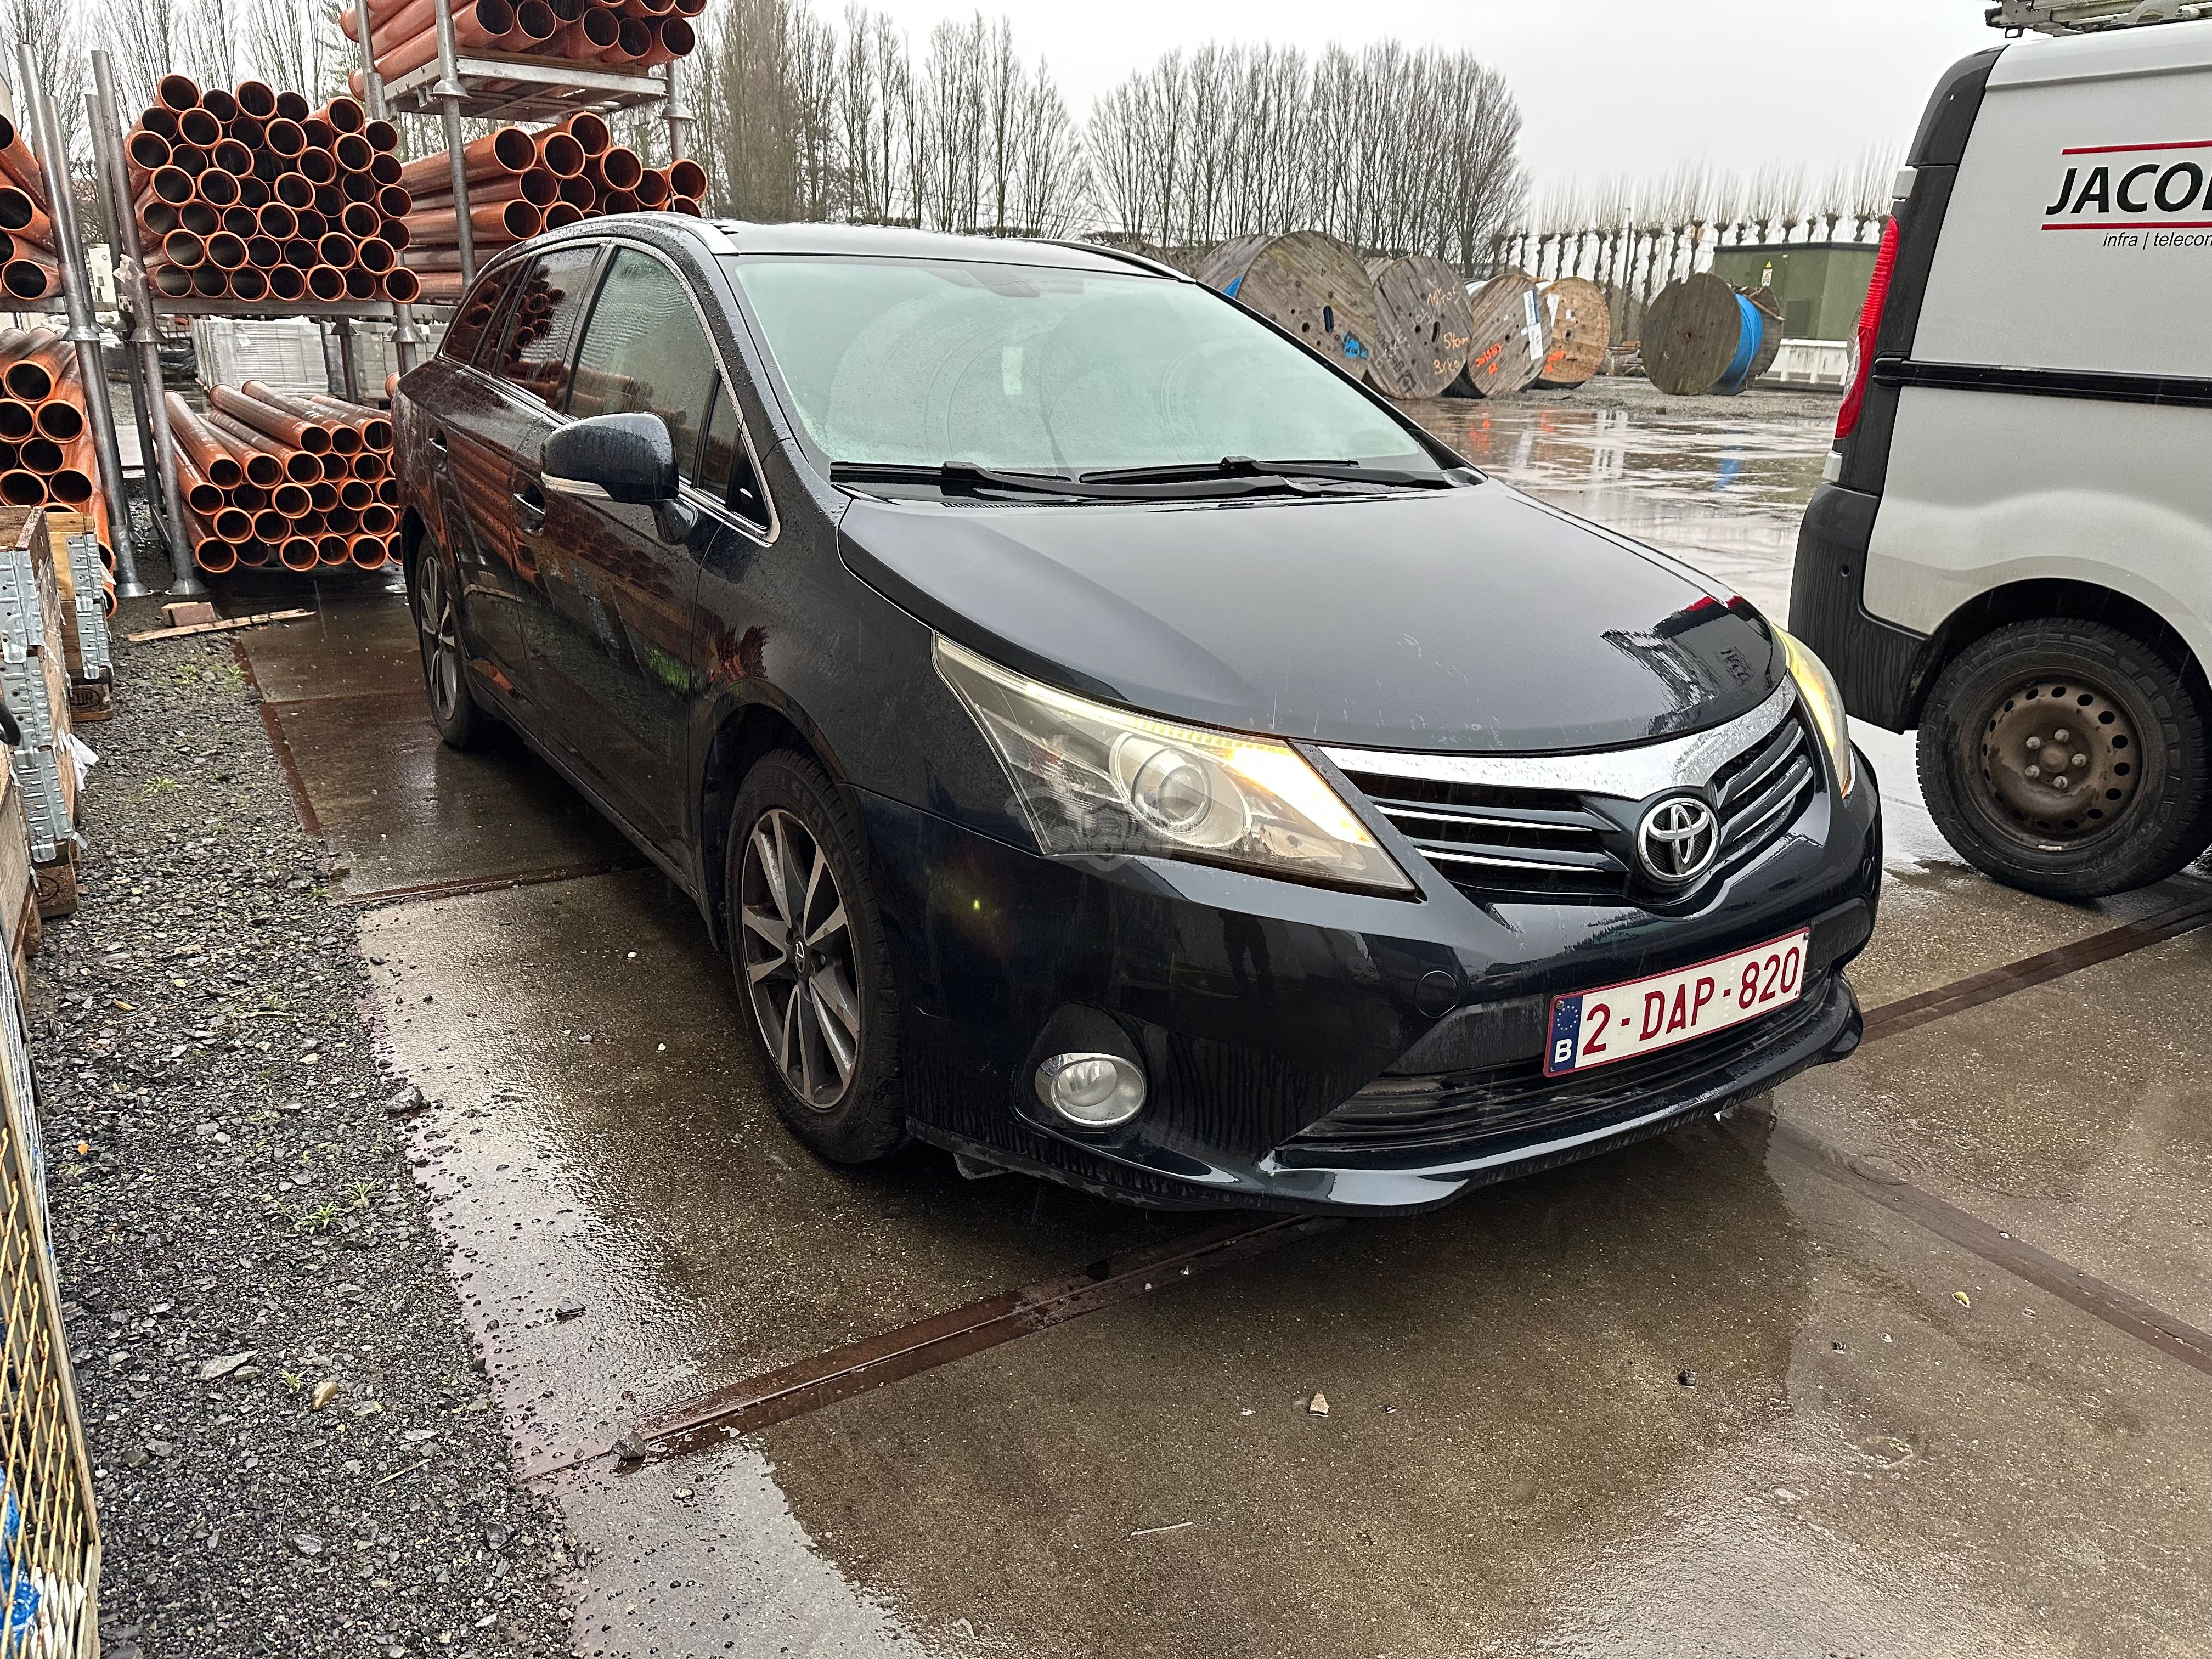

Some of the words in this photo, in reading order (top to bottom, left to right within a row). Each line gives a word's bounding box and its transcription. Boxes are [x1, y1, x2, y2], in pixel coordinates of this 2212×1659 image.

[2045, 162, 2212, 215] JACO
[2103, 232, 2138, 246] infra
[1554, 1039, 1572, 1064] B
